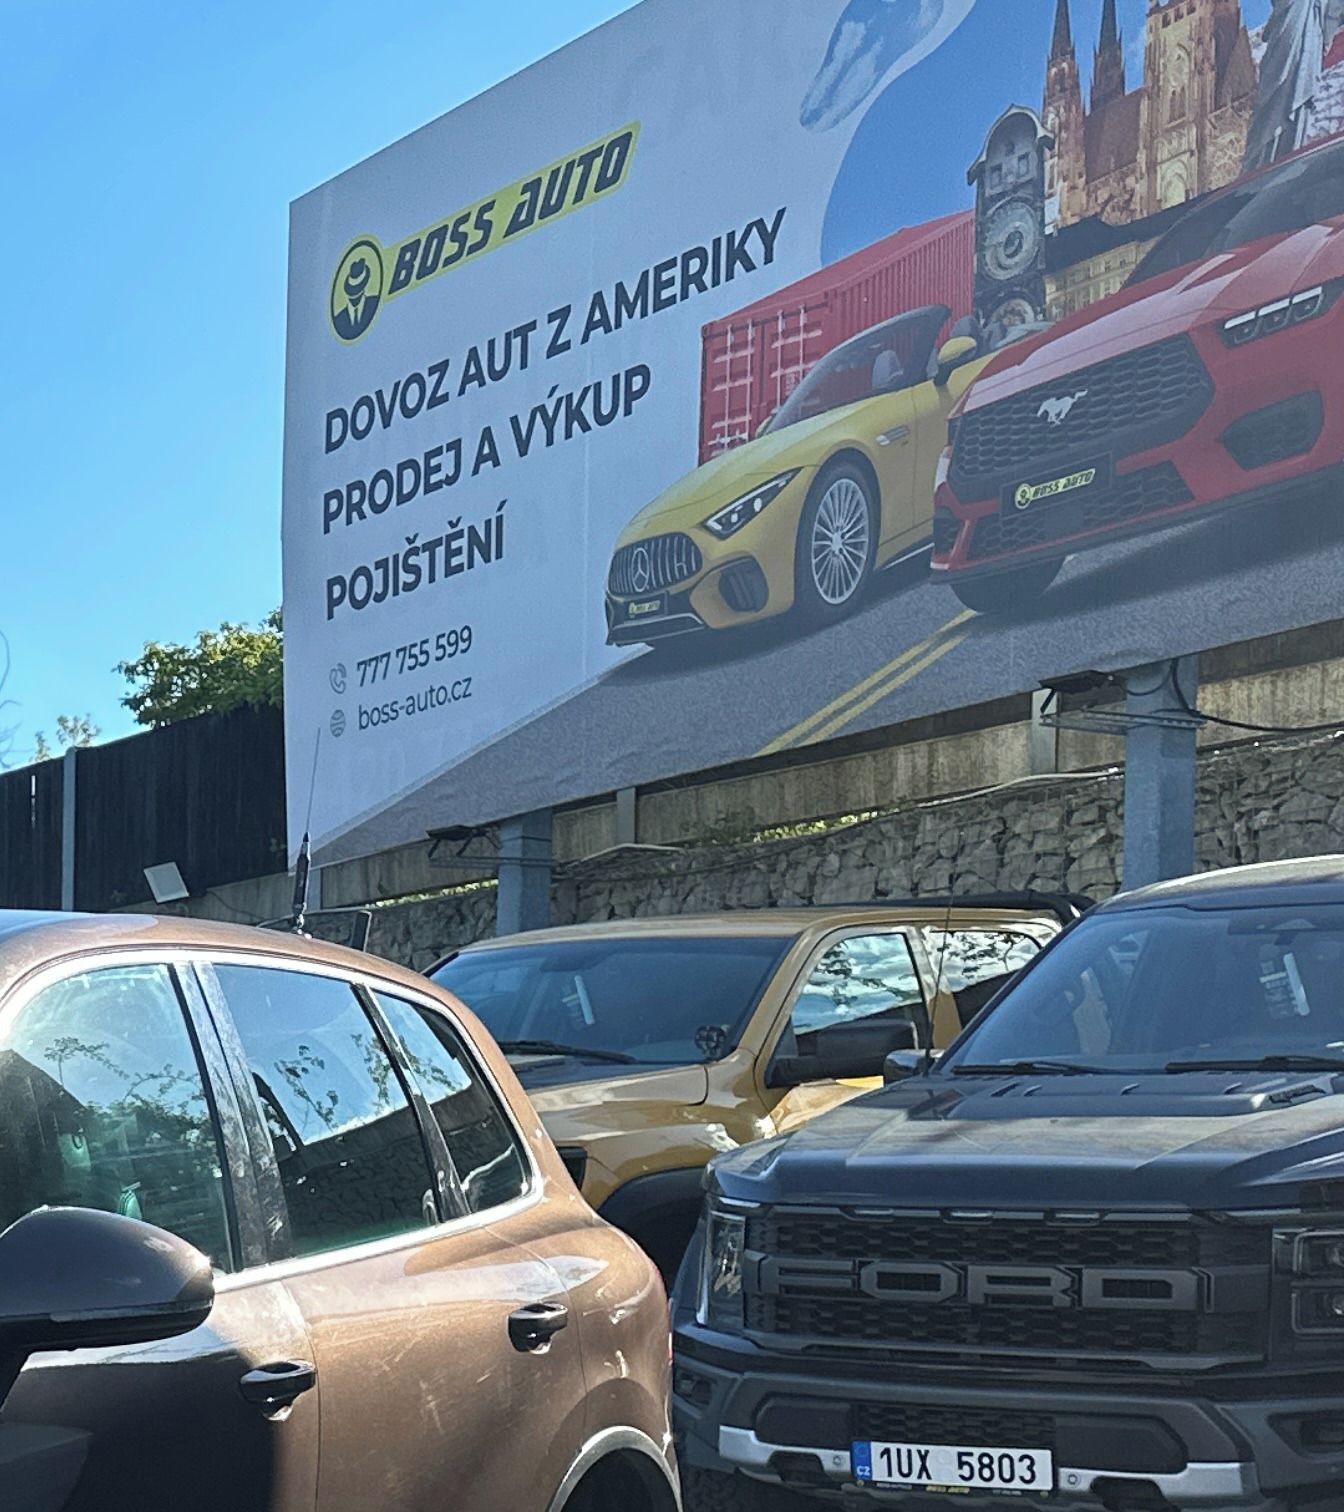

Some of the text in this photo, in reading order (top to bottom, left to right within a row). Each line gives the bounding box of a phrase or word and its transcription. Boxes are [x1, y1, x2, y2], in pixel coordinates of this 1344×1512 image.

[388, 130, 634, 295] BOSS AUTO
[325, 207, 787, 454] DOVOZ AUT Z AMERIKY
[323, 363, 651, 535] PRODEJ A VÝKUP
[326, 500, 508, 620] POJIŠTĚNÍ
[356, 625, 473, 688] 777 755 599
[358, 675, 472, 731] boss-auto.cz
[770, 1256, 1200, 1313] FORD
[857, 1465, 870, 1475] CZ
[880, 1448, 1036, 1484] 1UX 5803
